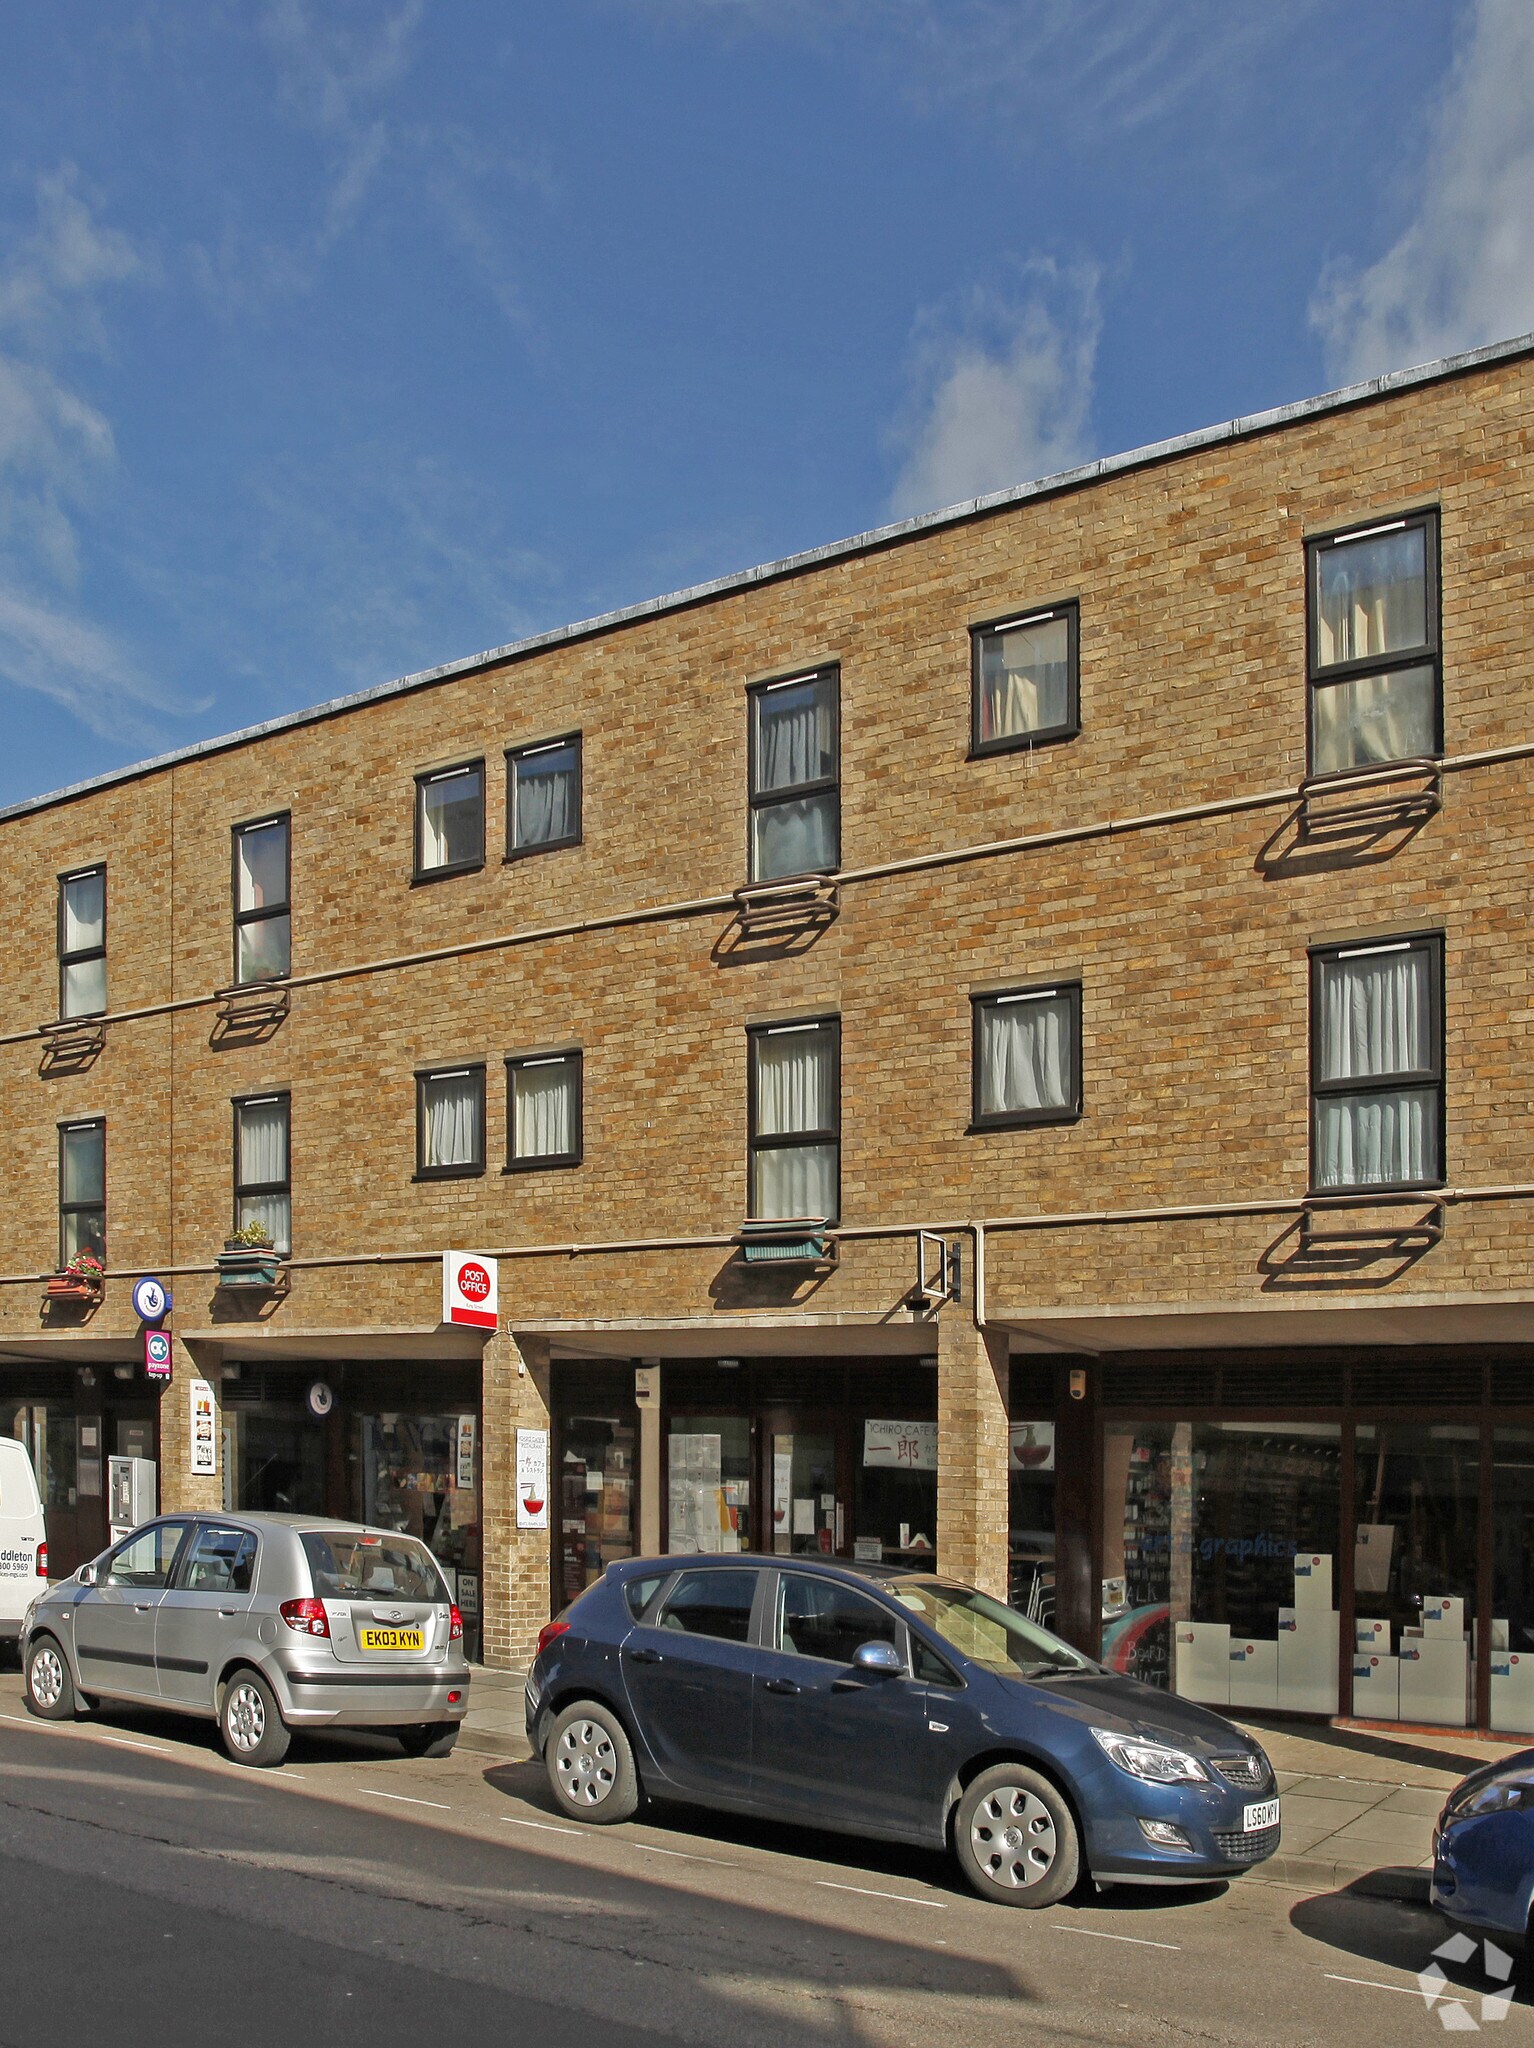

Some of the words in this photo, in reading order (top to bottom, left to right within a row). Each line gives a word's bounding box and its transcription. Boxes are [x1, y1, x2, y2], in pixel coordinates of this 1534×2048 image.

[464, 1269, 485, 1282] POST
[460, 1281, 487, 1294] OFFICE
[147, 1362, 170, 1370] payzone
[870, 1423, 902, 1435] ICHIRO
[905, 1425, 929, 1436] CAFE
[867, 1434, 919, 1467] 一郎
[1199, 1531, 1297, 1561] graphics
[12, 1562, 29, 1571] 5969
[462, 1578, 474, 1587] ON
[461, 1589, 475, 1598] SALE
[460, 1600, 477, 1608] HERE
[366, 1631, 397, 1646] EK03
[400, 1632, 420, 1647] KYN
[1246, 1805, 1267, 1828] LS60
